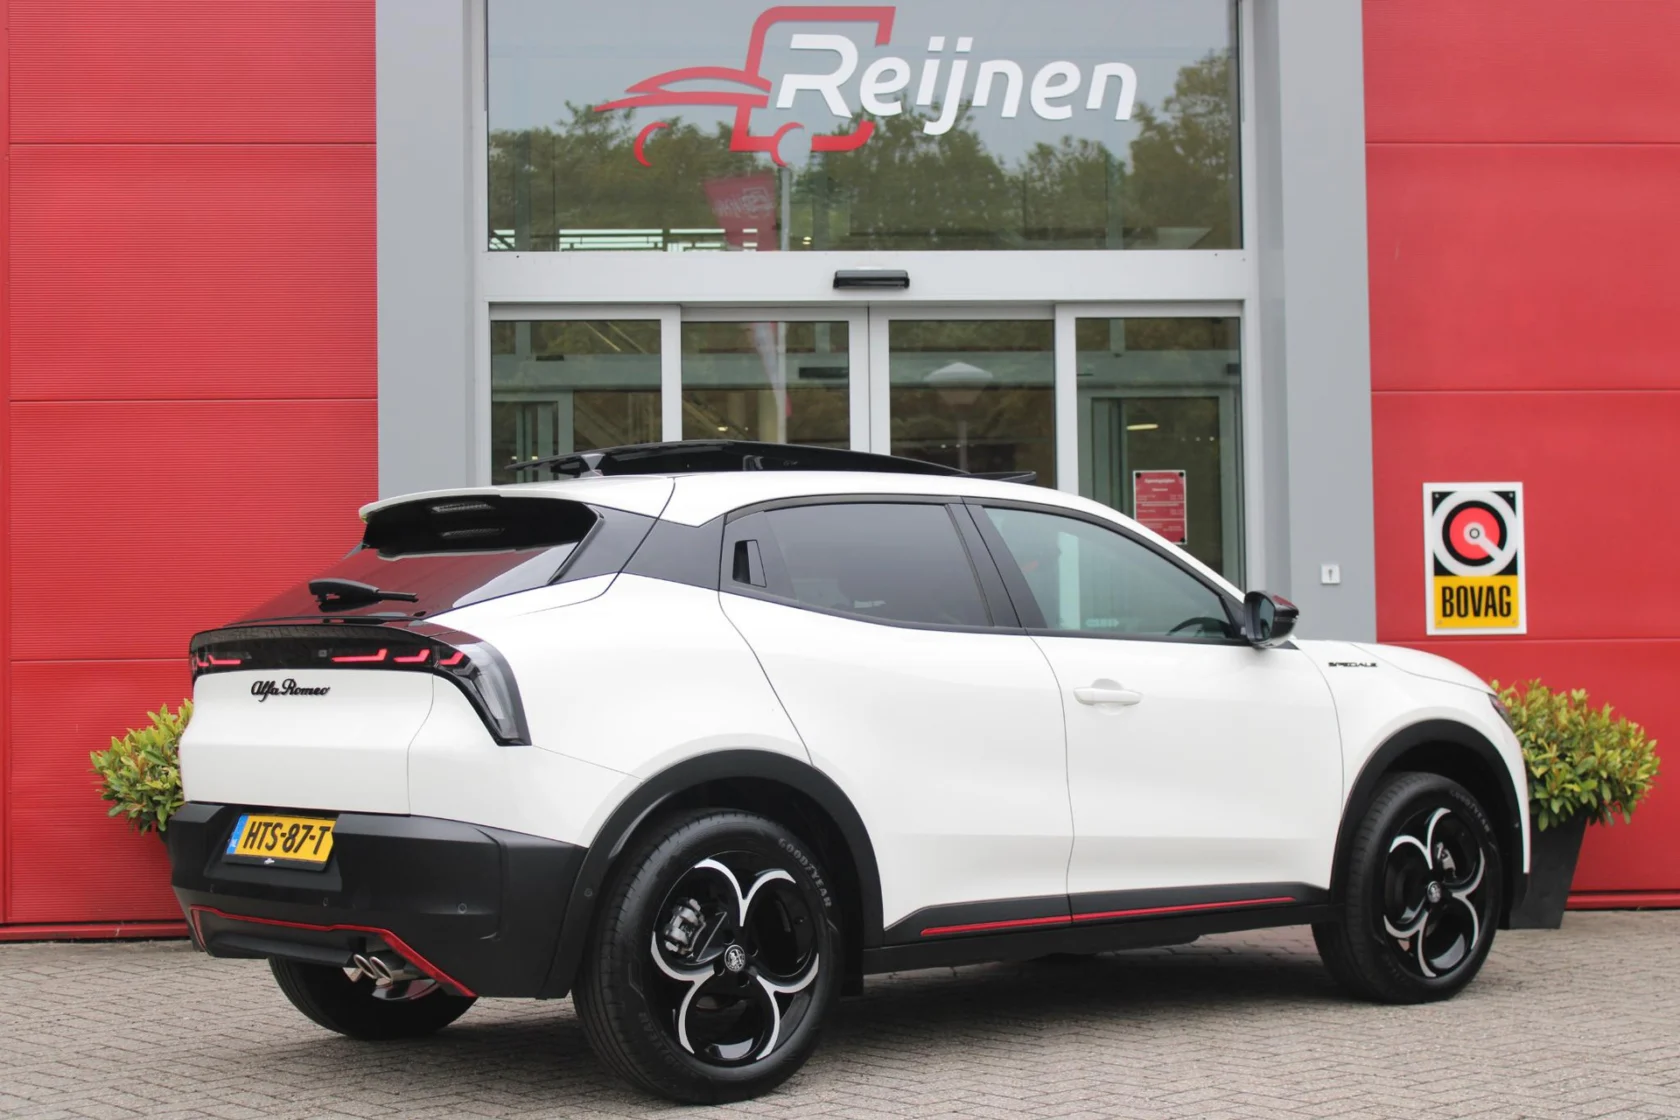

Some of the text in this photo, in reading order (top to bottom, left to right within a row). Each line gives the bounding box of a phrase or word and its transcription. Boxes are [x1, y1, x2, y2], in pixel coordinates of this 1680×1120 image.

[776, 33, 1138, 135] Reijnen
[1441, 585, 1511, 618] BOVAG
[251, 678, 331, 703] Alfa Romeo
[243, 821, 331, 855] HTS-87-T
[779, 838, 832, 907] GOODYEAR
